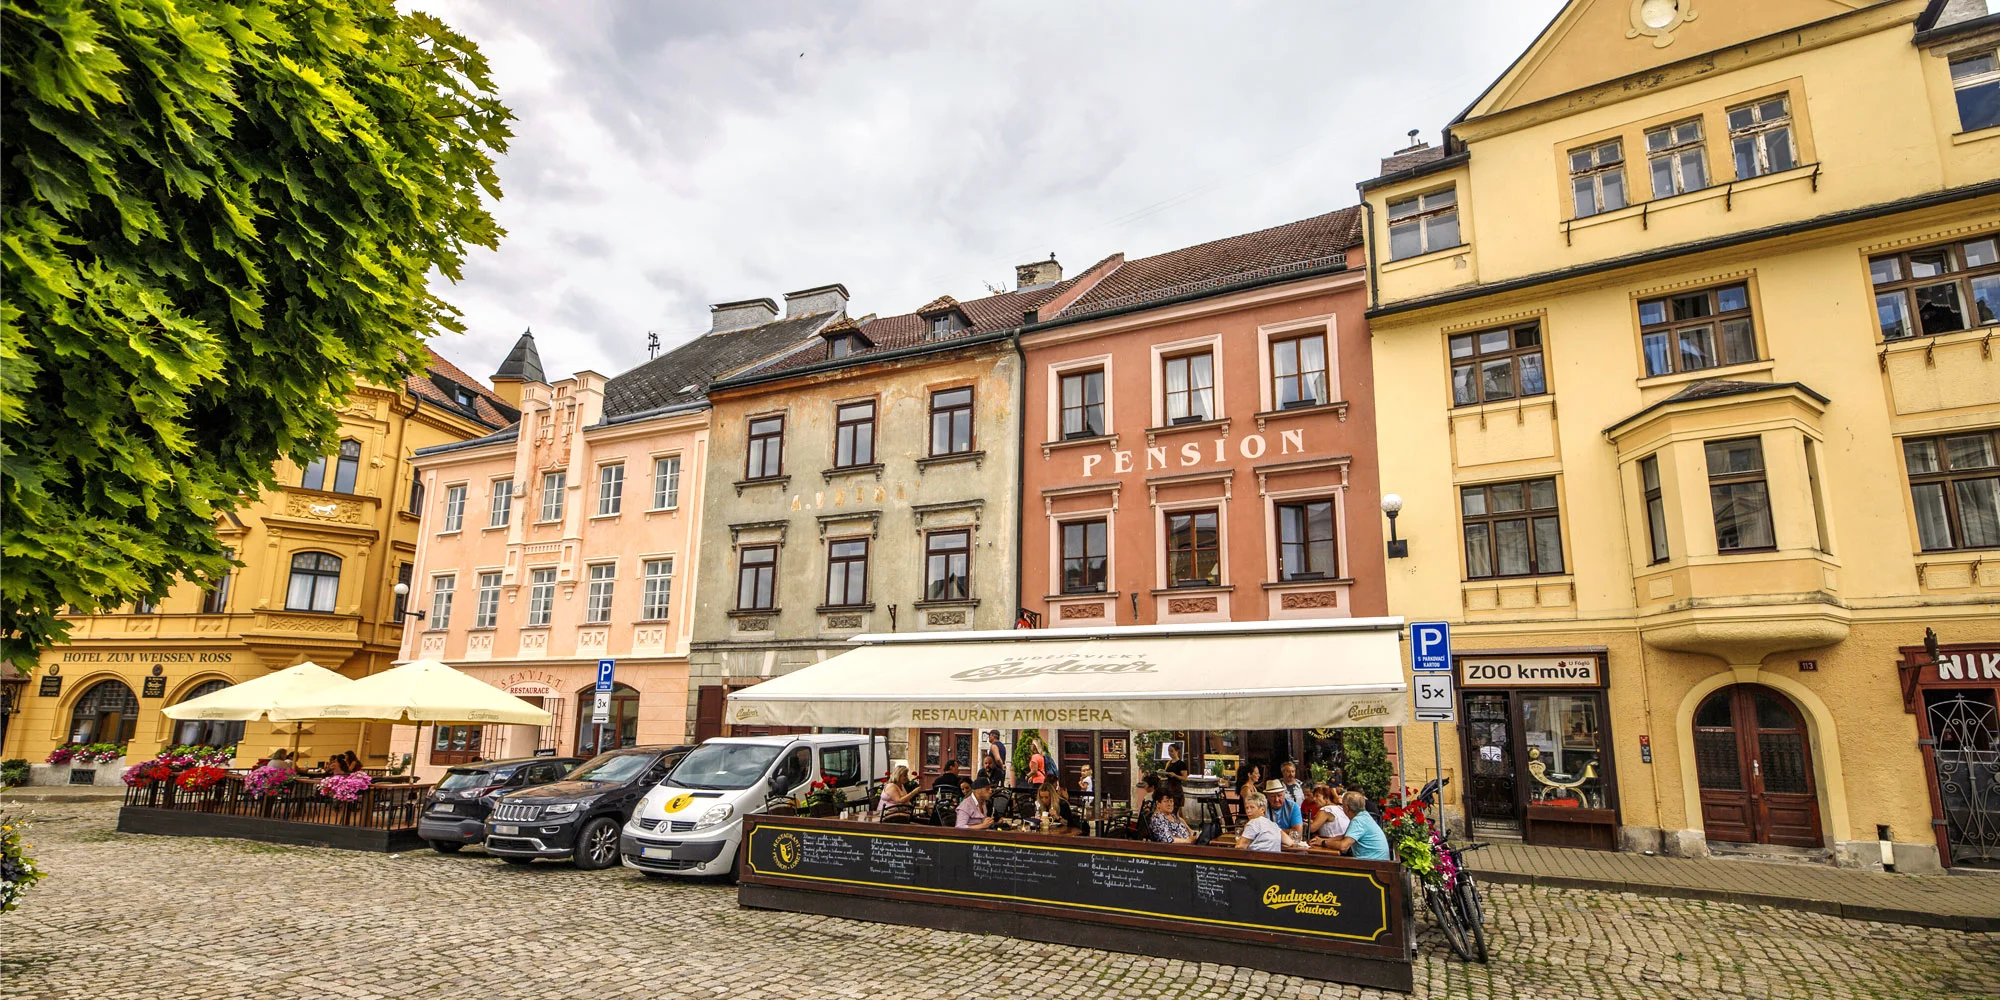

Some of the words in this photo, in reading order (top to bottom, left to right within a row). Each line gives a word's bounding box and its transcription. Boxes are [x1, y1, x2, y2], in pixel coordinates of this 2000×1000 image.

[1082, 428, 1304, 477] PENSION
[1420, 628, 1442, 656] P
[63, 652, 102, 662] HOTEL
[107, 652, 134, 662] ZUM
[139, 652, 196, 662] WEISSEN
[199, 652, 232, 662] ROSS
[601, 663, 611, 681] P
[950, 659, 1158, 682] Budvar
[1468, 665, 1512, 679] ZOO
[1517, 664, 1591, 679] krmiva
[1802, 662, 1814, 670] 113
[500, 669, 562, 688] SENVIET
[911, 708, 1009, 721] RESTAURANT
[1012, 706, 1114, 722] ATMOSFÉRA
[1347, 704, 1390, 721] Budvar
[1262, 884, 1342, 908] Budweiser
[1295, 901, 1340, 917] Budvar
